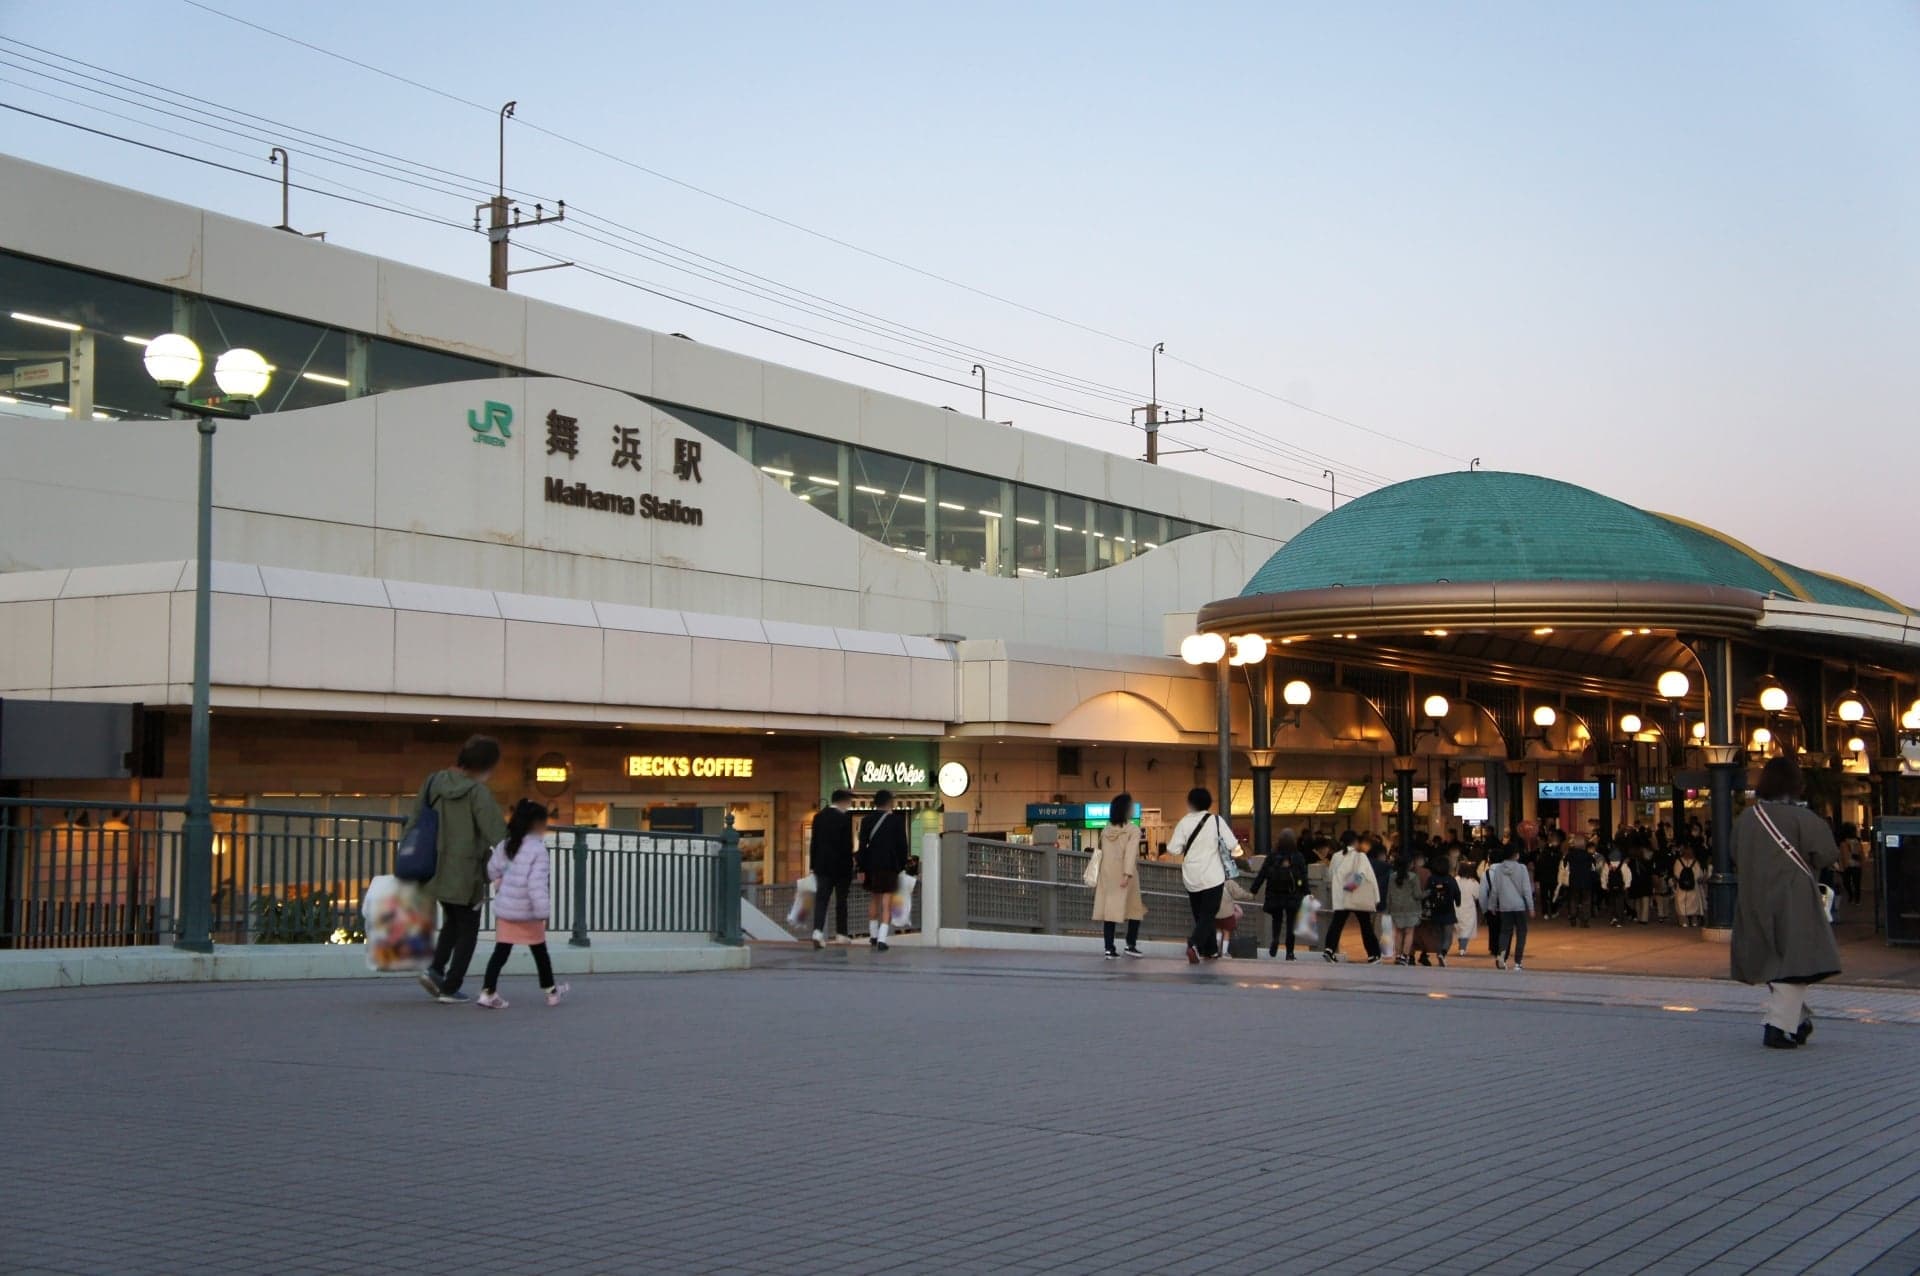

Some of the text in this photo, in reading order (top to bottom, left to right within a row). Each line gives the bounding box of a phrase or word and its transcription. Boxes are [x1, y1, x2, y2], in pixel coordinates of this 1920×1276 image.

[468, 400, 512, 438] JR
[546, 408, 702, 484] 舞浜駅
[545, 476, 703, 527] Maihama Station
[629, 756, 753, 777] BECK'S COFFEE
[862, 760, 894, 783] Bell's
